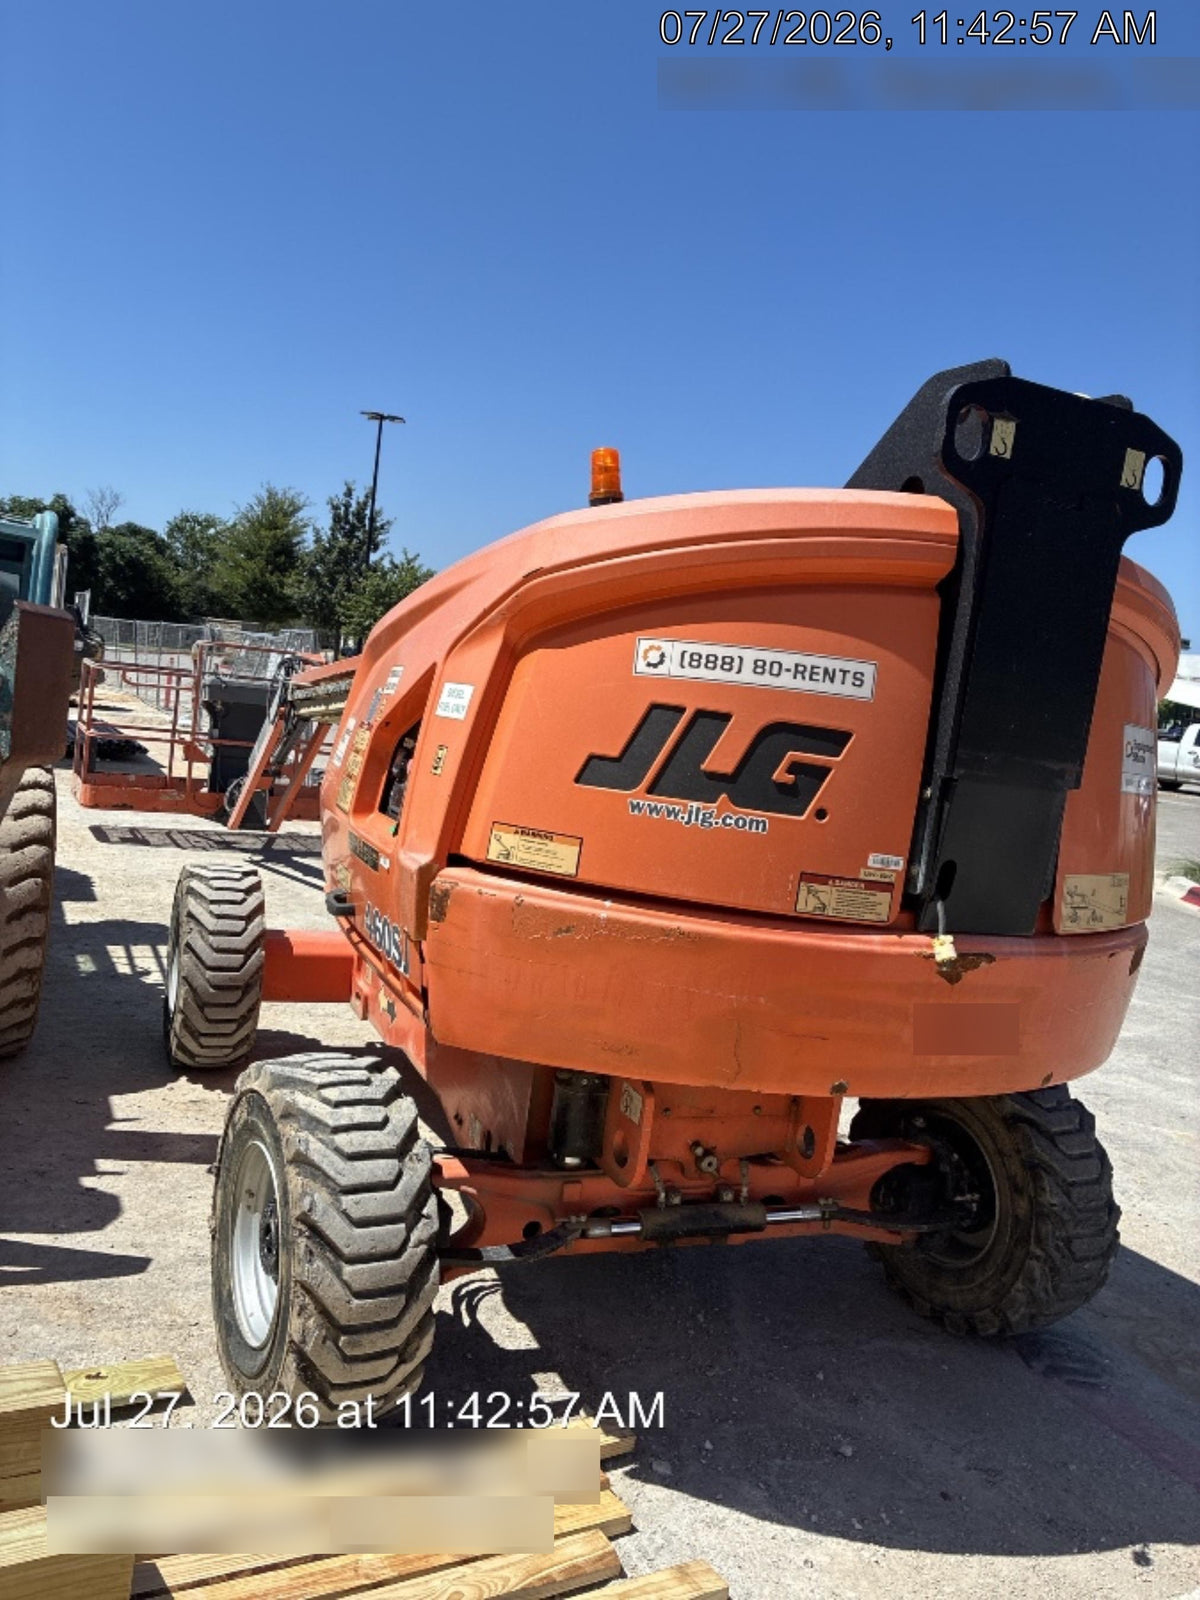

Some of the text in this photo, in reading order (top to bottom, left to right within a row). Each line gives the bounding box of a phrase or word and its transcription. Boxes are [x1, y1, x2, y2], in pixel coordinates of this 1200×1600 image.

[678, 650, 866, 688] (888) 80-RENTS
[573, 702, 855, 820] JLG
[627, 798, 769, 834] www.jlg.com
